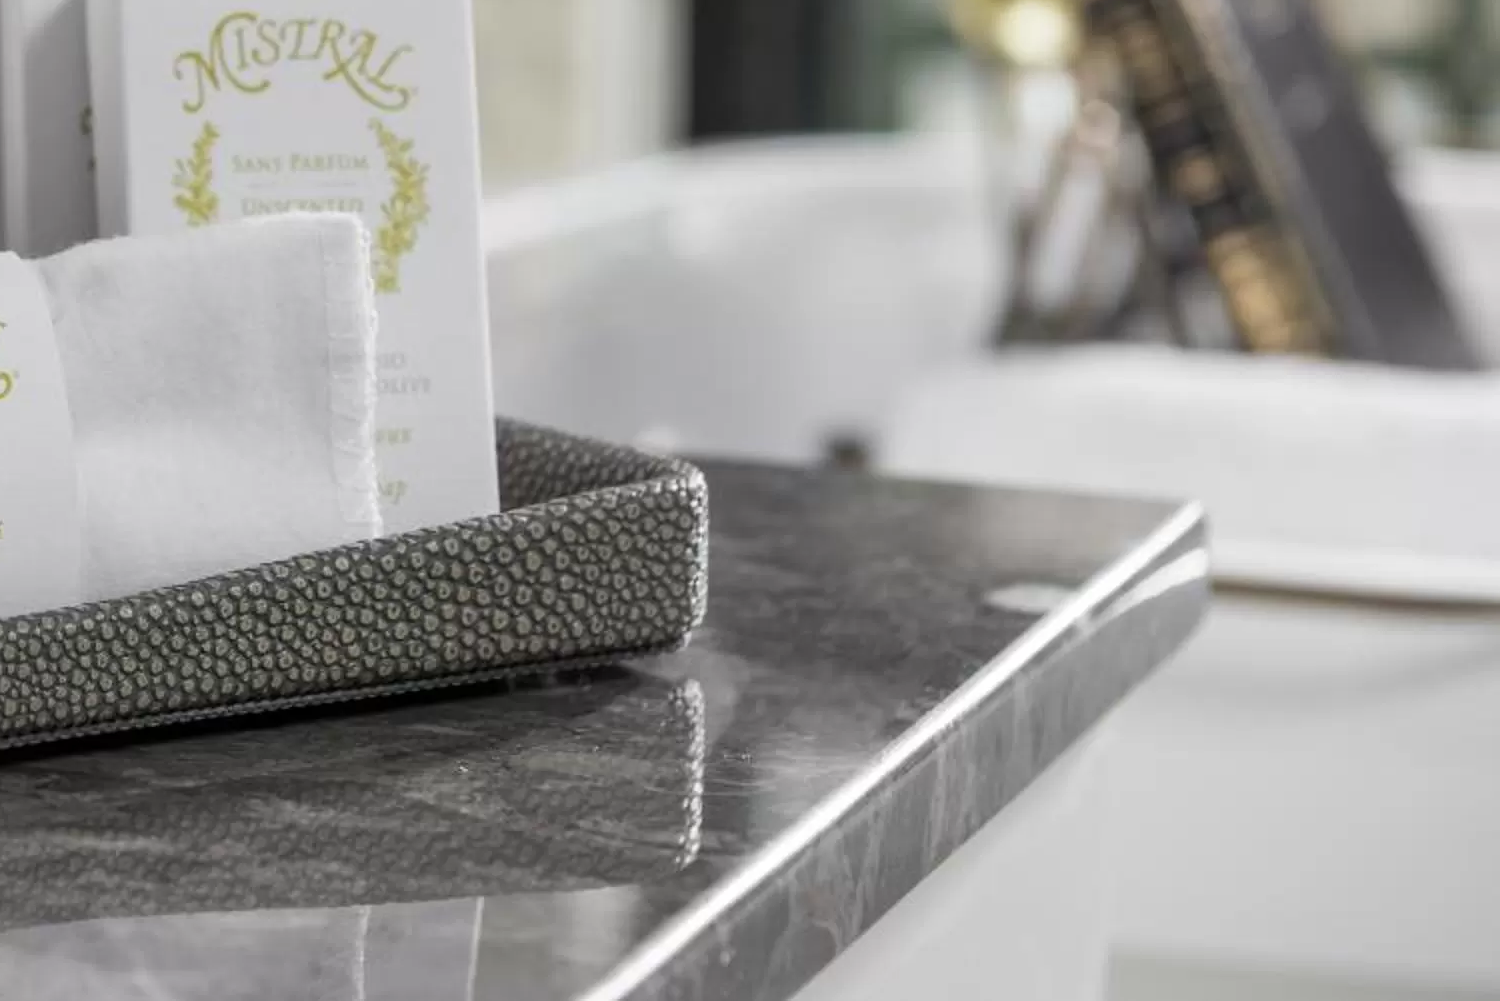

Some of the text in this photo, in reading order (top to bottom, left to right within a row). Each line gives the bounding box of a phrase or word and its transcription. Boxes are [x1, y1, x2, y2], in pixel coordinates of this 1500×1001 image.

[173, 11, 413, 114] MISTRAL
[231, 152, 370, 173] SANS PARFUM
